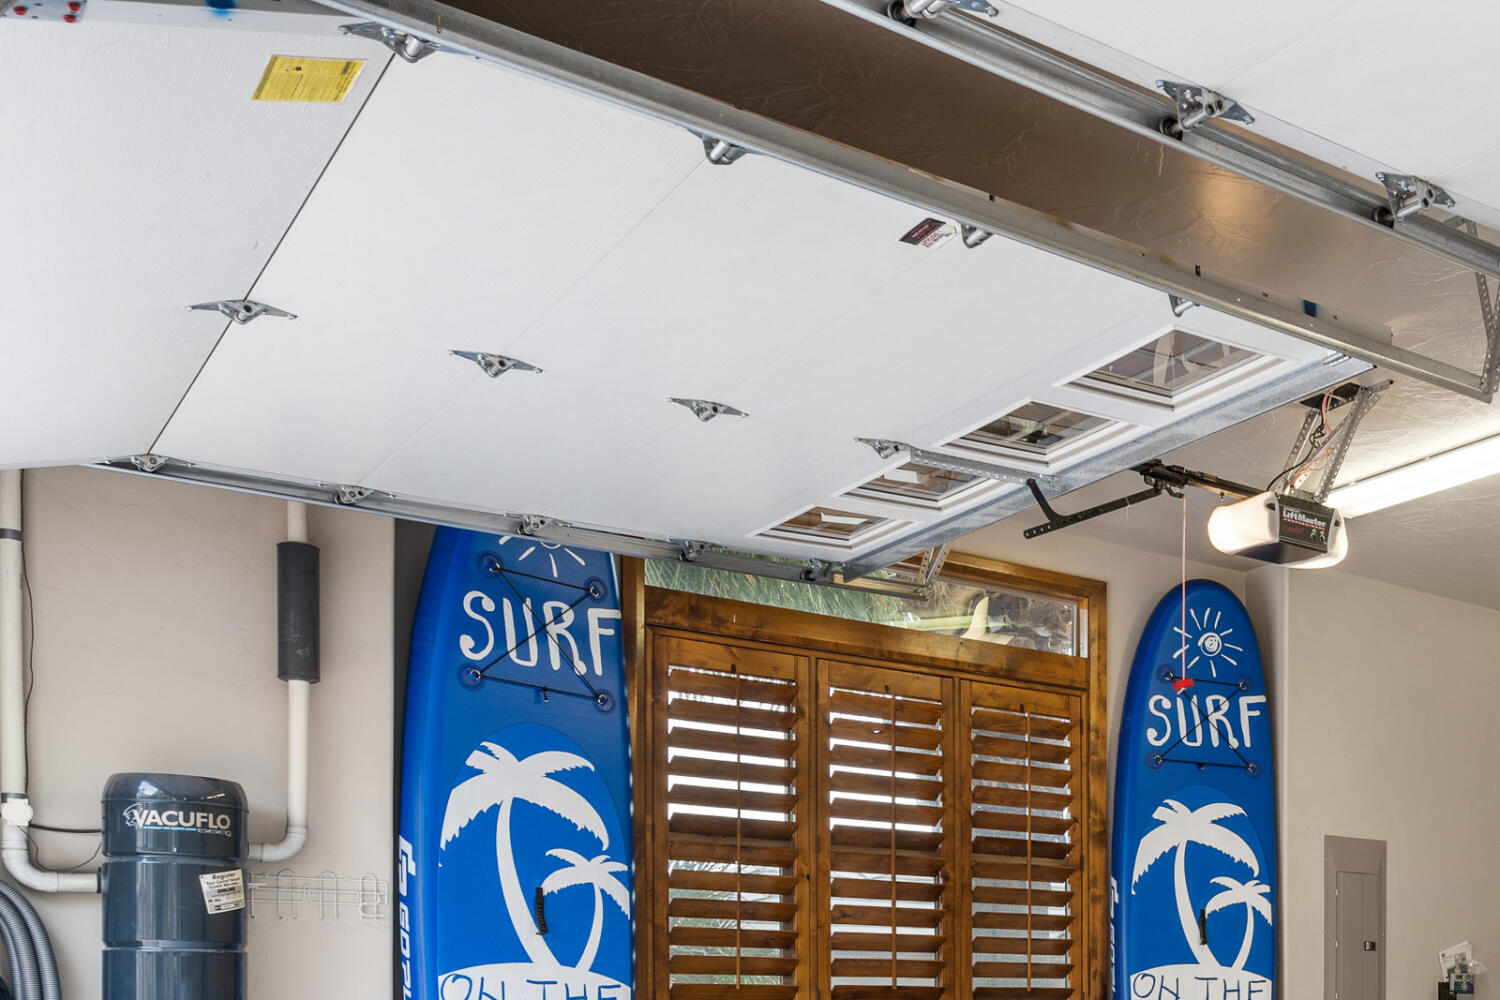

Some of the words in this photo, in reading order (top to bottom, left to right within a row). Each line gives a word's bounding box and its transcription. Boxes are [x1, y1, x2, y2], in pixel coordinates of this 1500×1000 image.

[1283, 509, 1326, 527] LiftMaster
[459, 590, 622, 676] SURF
[1146, 694, 1266, 749] SURF
[133, 809, 231, 830] VACUFLO
